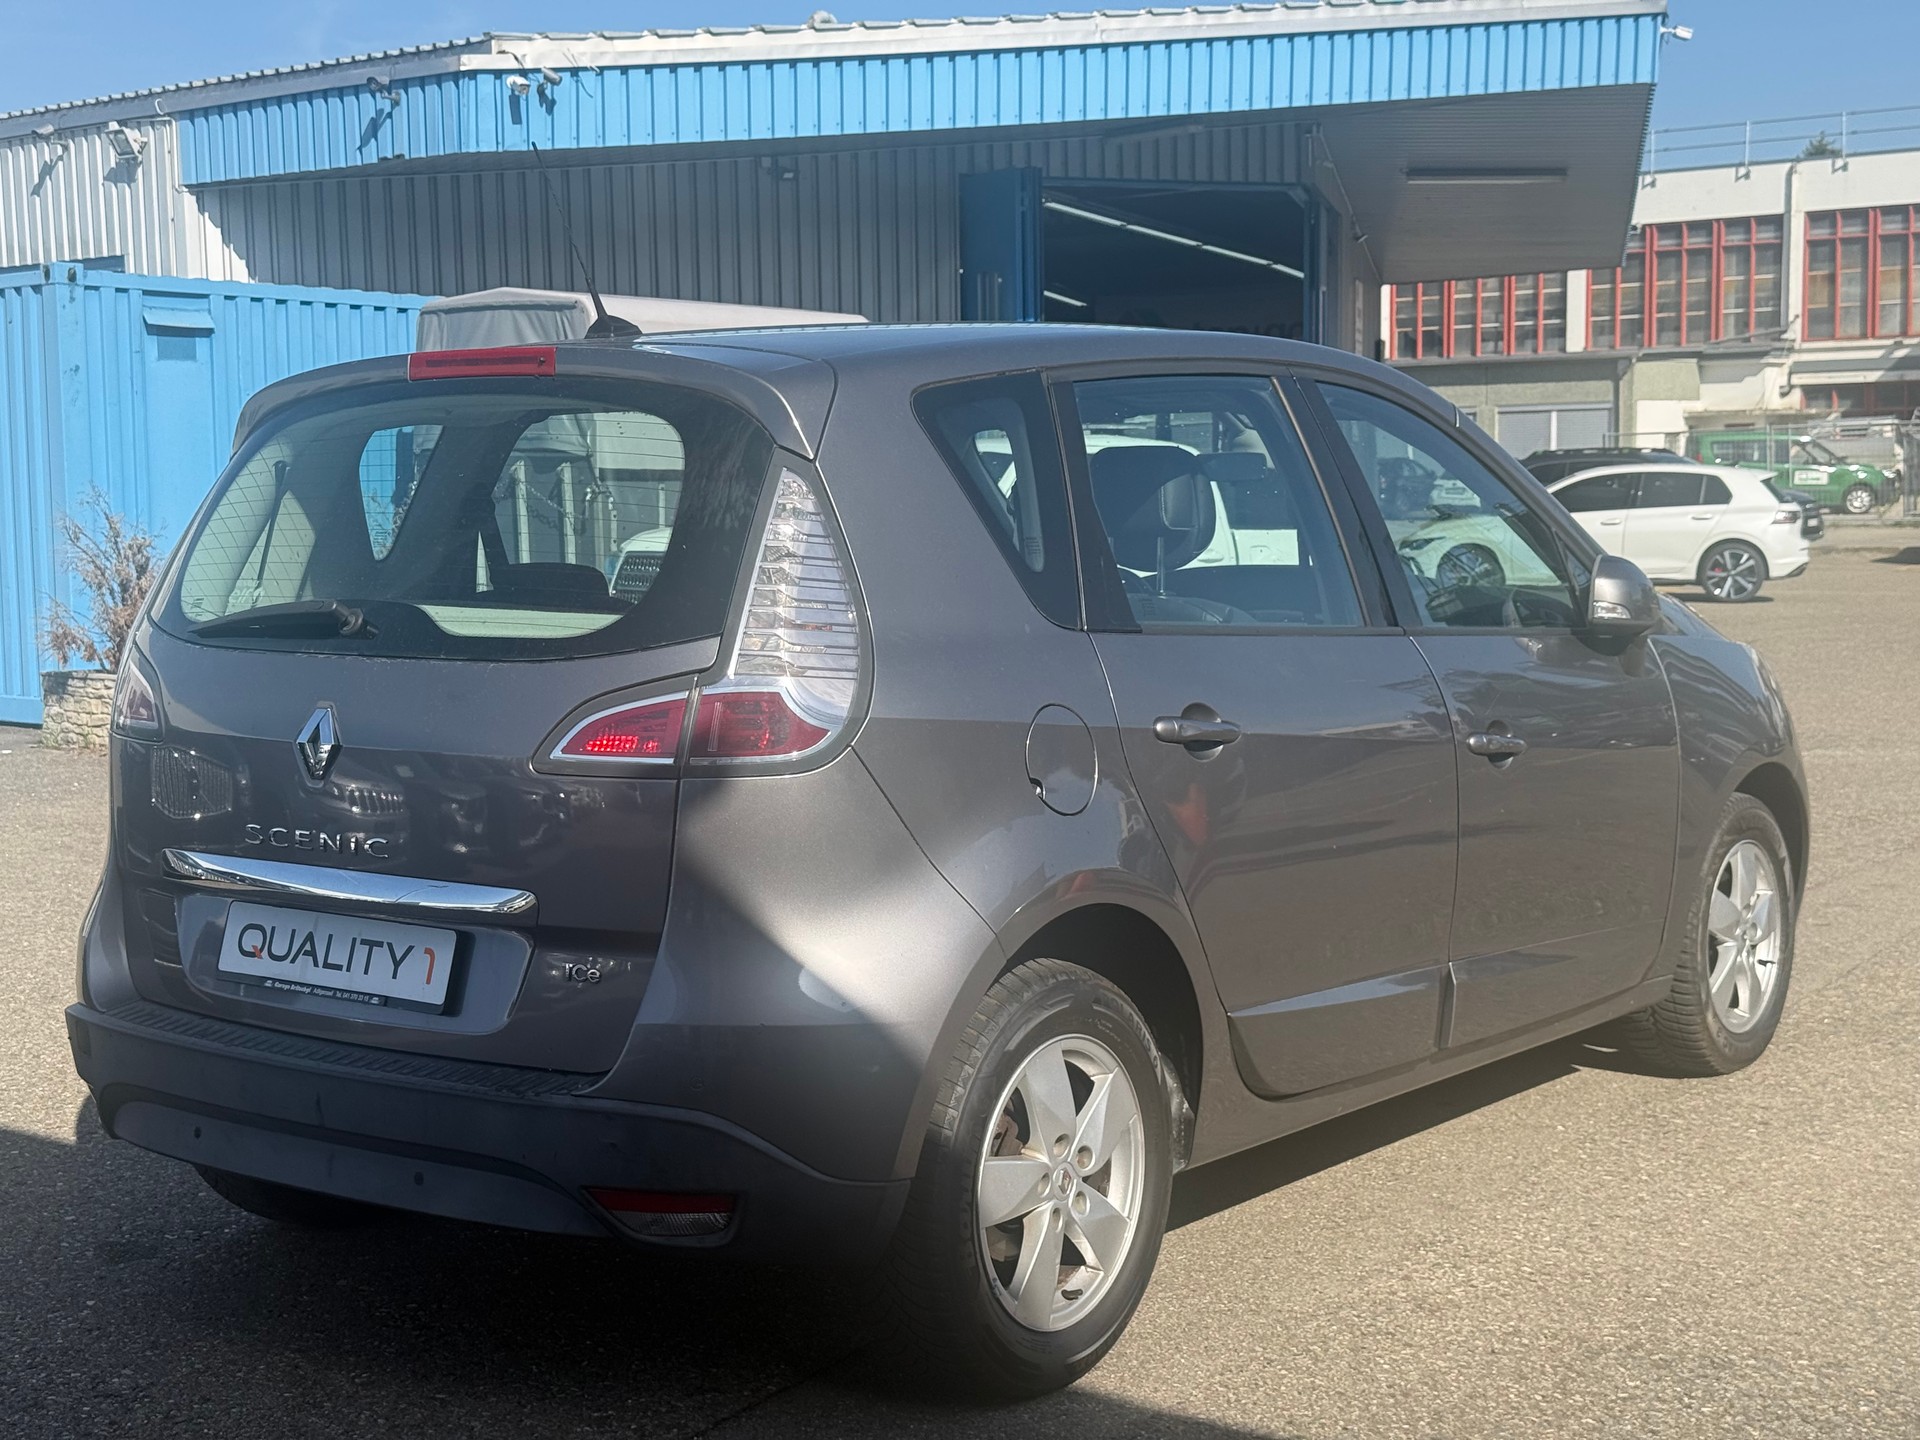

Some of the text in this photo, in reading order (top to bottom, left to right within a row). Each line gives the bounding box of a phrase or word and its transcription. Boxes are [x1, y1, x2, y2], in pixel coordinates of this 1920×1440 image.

[245, 824, 389, 858] SCENIC
[238, 923, 436, 985] QUALITY 1
[562, 962, 601, 983] TCe
